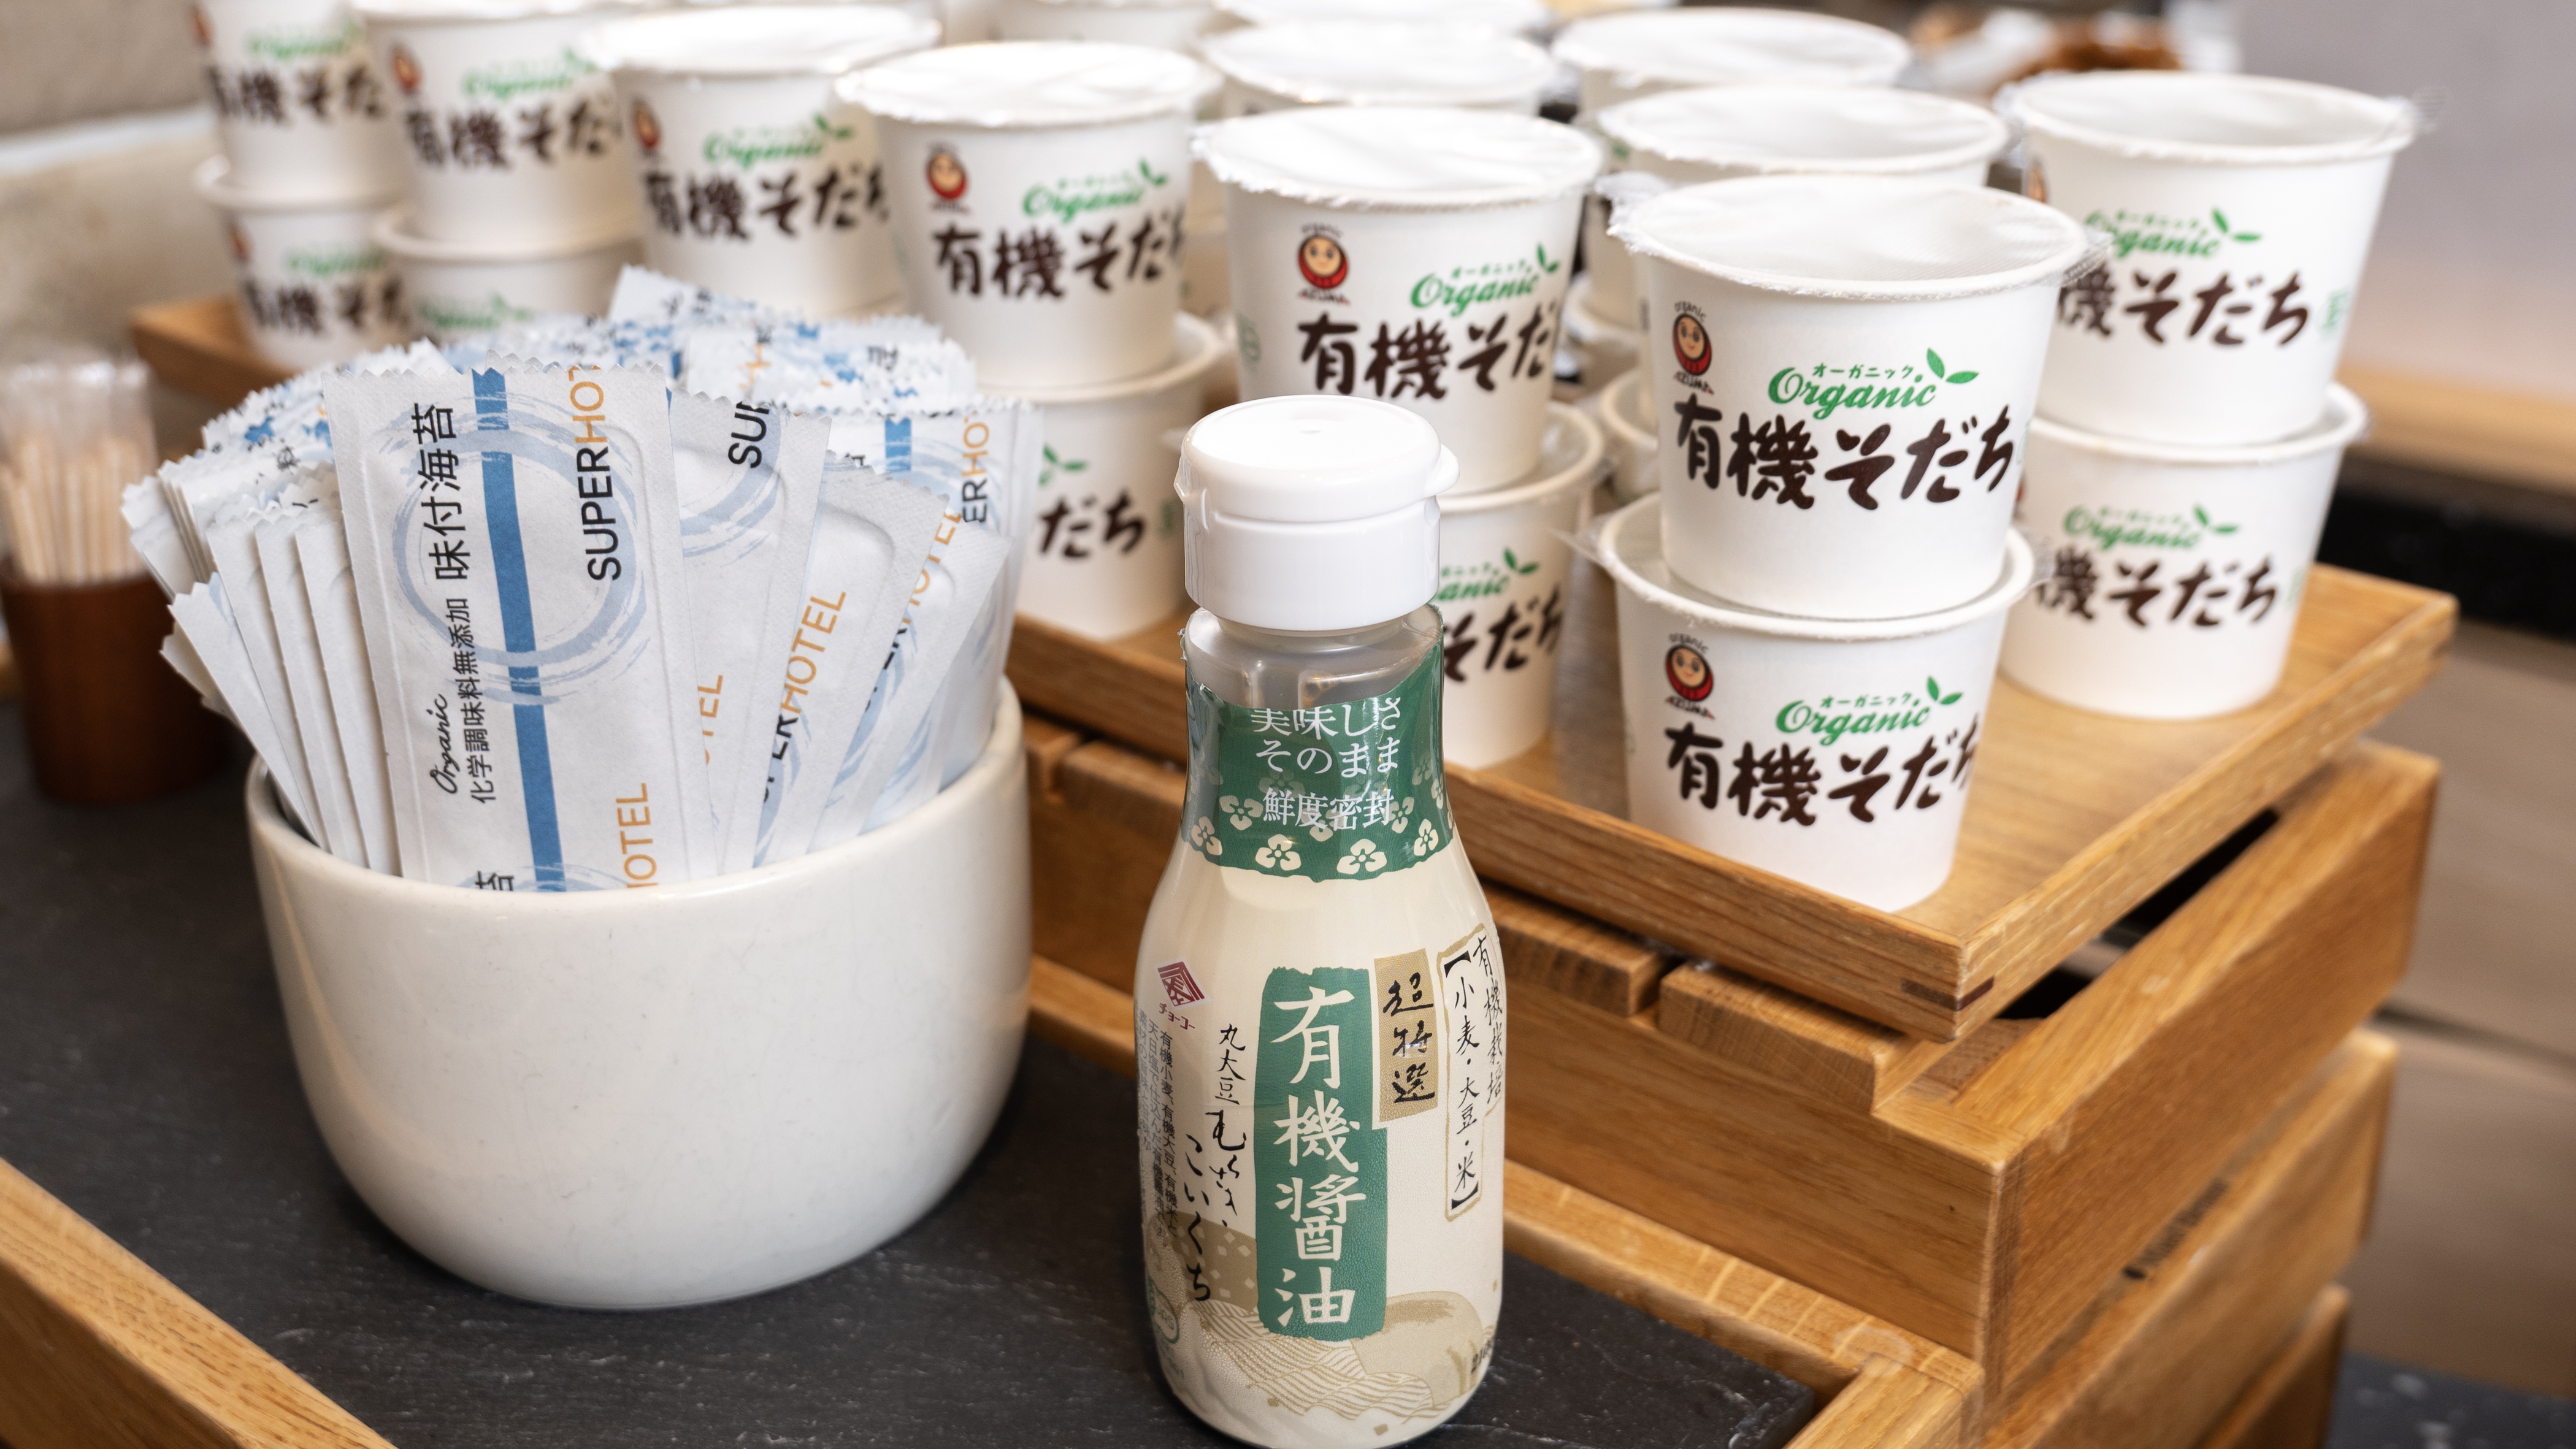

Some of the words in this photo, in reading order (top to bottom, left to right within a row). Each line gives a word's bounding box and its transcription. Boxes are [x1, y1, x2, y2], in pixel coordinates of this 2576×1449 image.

[1409, 272, 1539, 318] Organic
[1298, 299, 1561, 400] 有機そだ
[1768, 367, 1936, 420] Organic
[1812, 363, 1914, 379] オーガニック
[411, 403, 472, 581] 味付海苔
[1674, 393, 2014, 510] 有機そだち
[430, 694, 460, 795] Organic
[447, 597, 496, 804] 化学調味料無添加
[1251, 697, 1401, 740] 美味しさ
[1775, 698, 1931, 747] Organic
[1820, 692, 1912, 708] オーガニック
[1256, 736, 1400, 778] そのまま
[615, 782, 659, 888] OTEL
[1263, 787, 1395, 832] 鮮度密封
[1159, 1002, 1196, 1030] チョーコー
[1382, 972, 1435, 1104] 超特選
[1473, 935, 1503, 1104] 有機栽培
[1214, 1023, 1246, 1106] 丸大豆
[1270, 985, 1367, 1328] 有機醤油
[1183, 1133, 1211, 1301] こいくち
